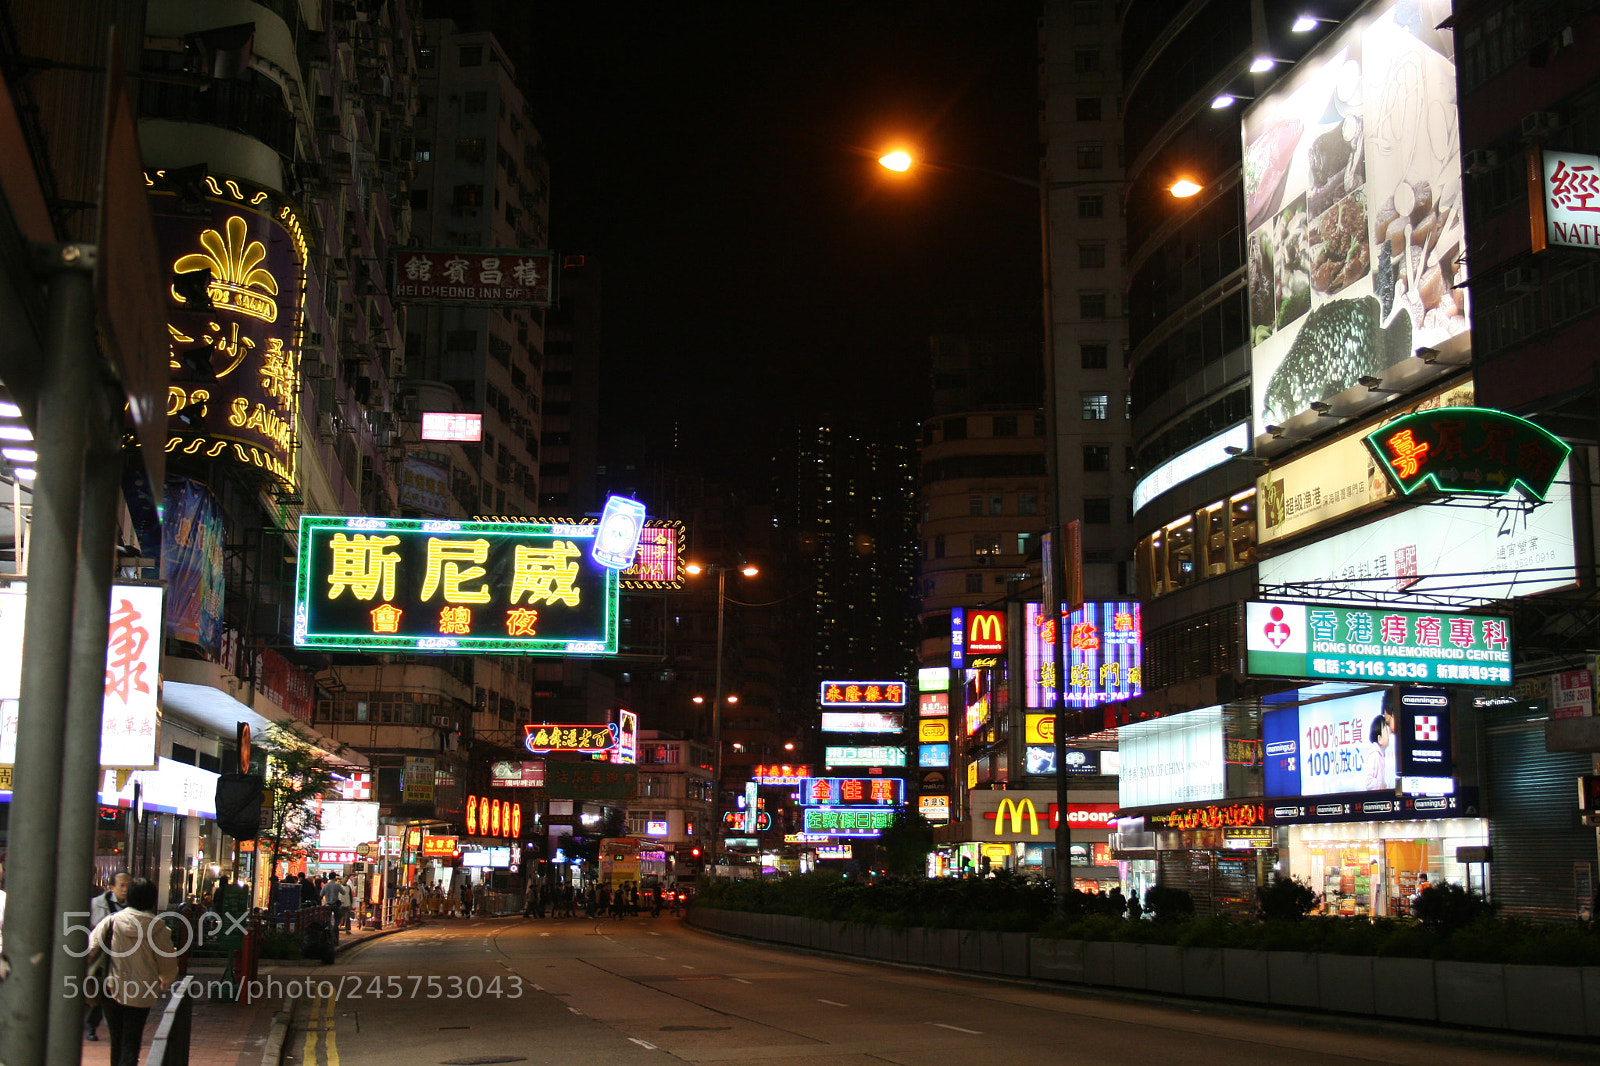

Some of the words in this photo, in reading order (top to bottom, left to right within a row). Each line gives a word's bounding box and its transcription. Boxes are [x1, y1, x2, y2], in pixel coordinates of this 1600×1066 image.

[397, 285, 418, 296] HEI
[422, 286, 475, 298] CHEONG
[480, 287, 501, 299] INN
[370, 604, 537, 636] 夜總會
[1310, 609, 1509, 650] 香港痔瘡專科
[1312, 641, 1346, 655] HONG
[1348, 643, 1381, 657] KONG
[1383, 645, 1464, 660] HAEMORRHOID
[1466, 649, 1510, 662] CENTRE
[1387, 661, 1428, 678] 3836
[1404, 696, 1438, 705] mannings
[1416, 799, 1441, 809] mannings
